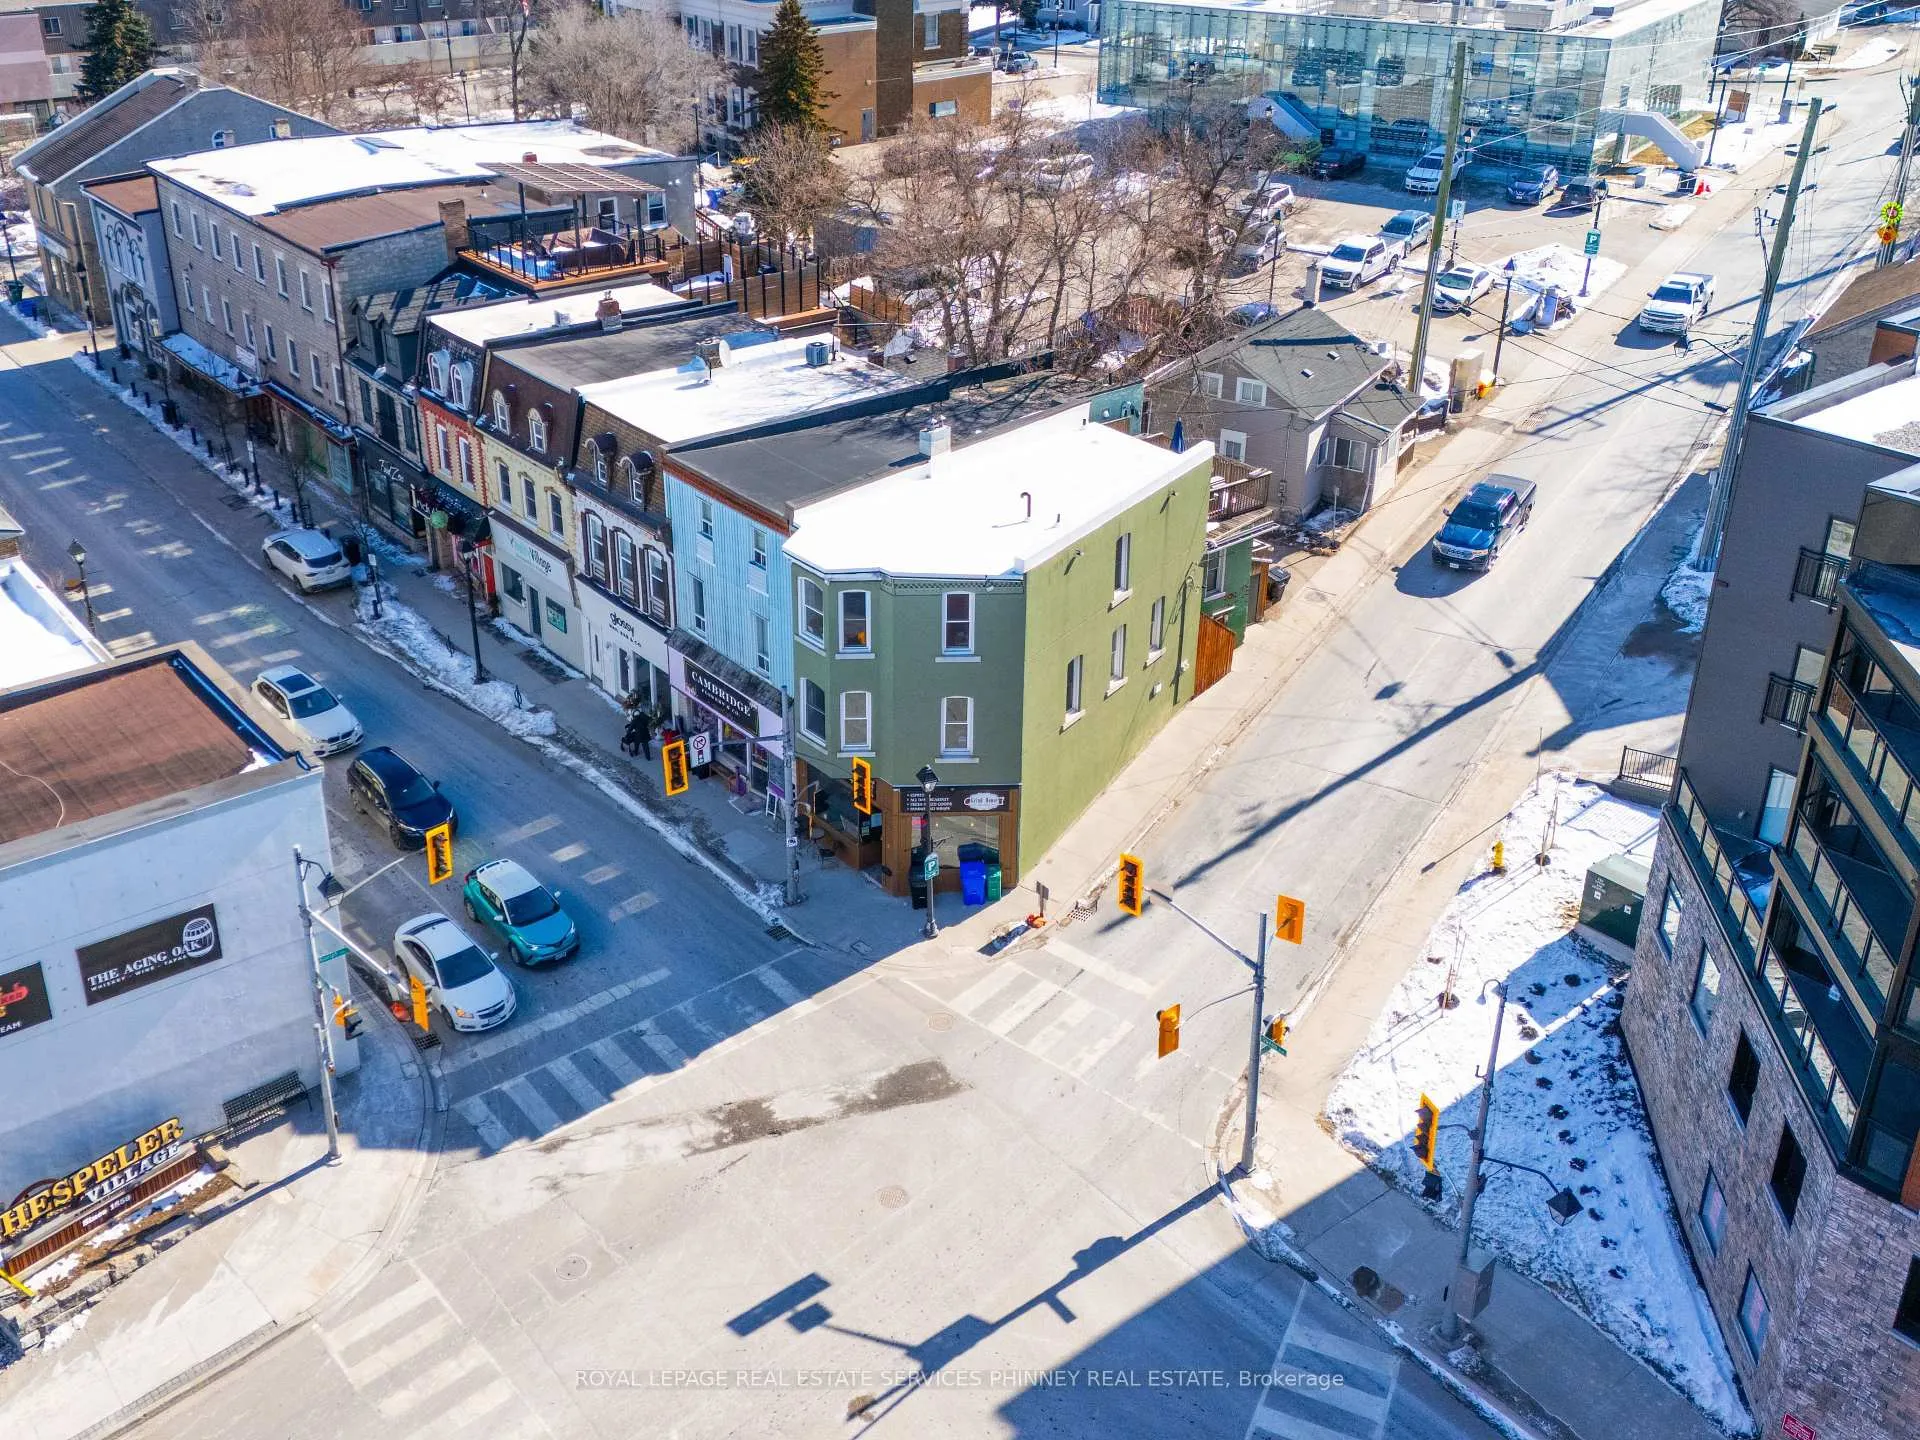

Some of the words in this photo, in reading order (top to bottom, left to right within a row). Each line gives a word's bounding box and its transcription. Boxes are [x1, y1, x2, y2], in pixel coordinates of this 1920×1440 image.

[691, 671, 751, 717] CAMBRIDGE
[928, 860, 936, 871] P
[88, 967, 120, 987] THE
[123, 951, 168, 975] AGING
[172, 938, 202, 957] OAK
[0, 1117, 184, 1237] HESPELER
[85, 1141, 181, 1203] VILLAGE
